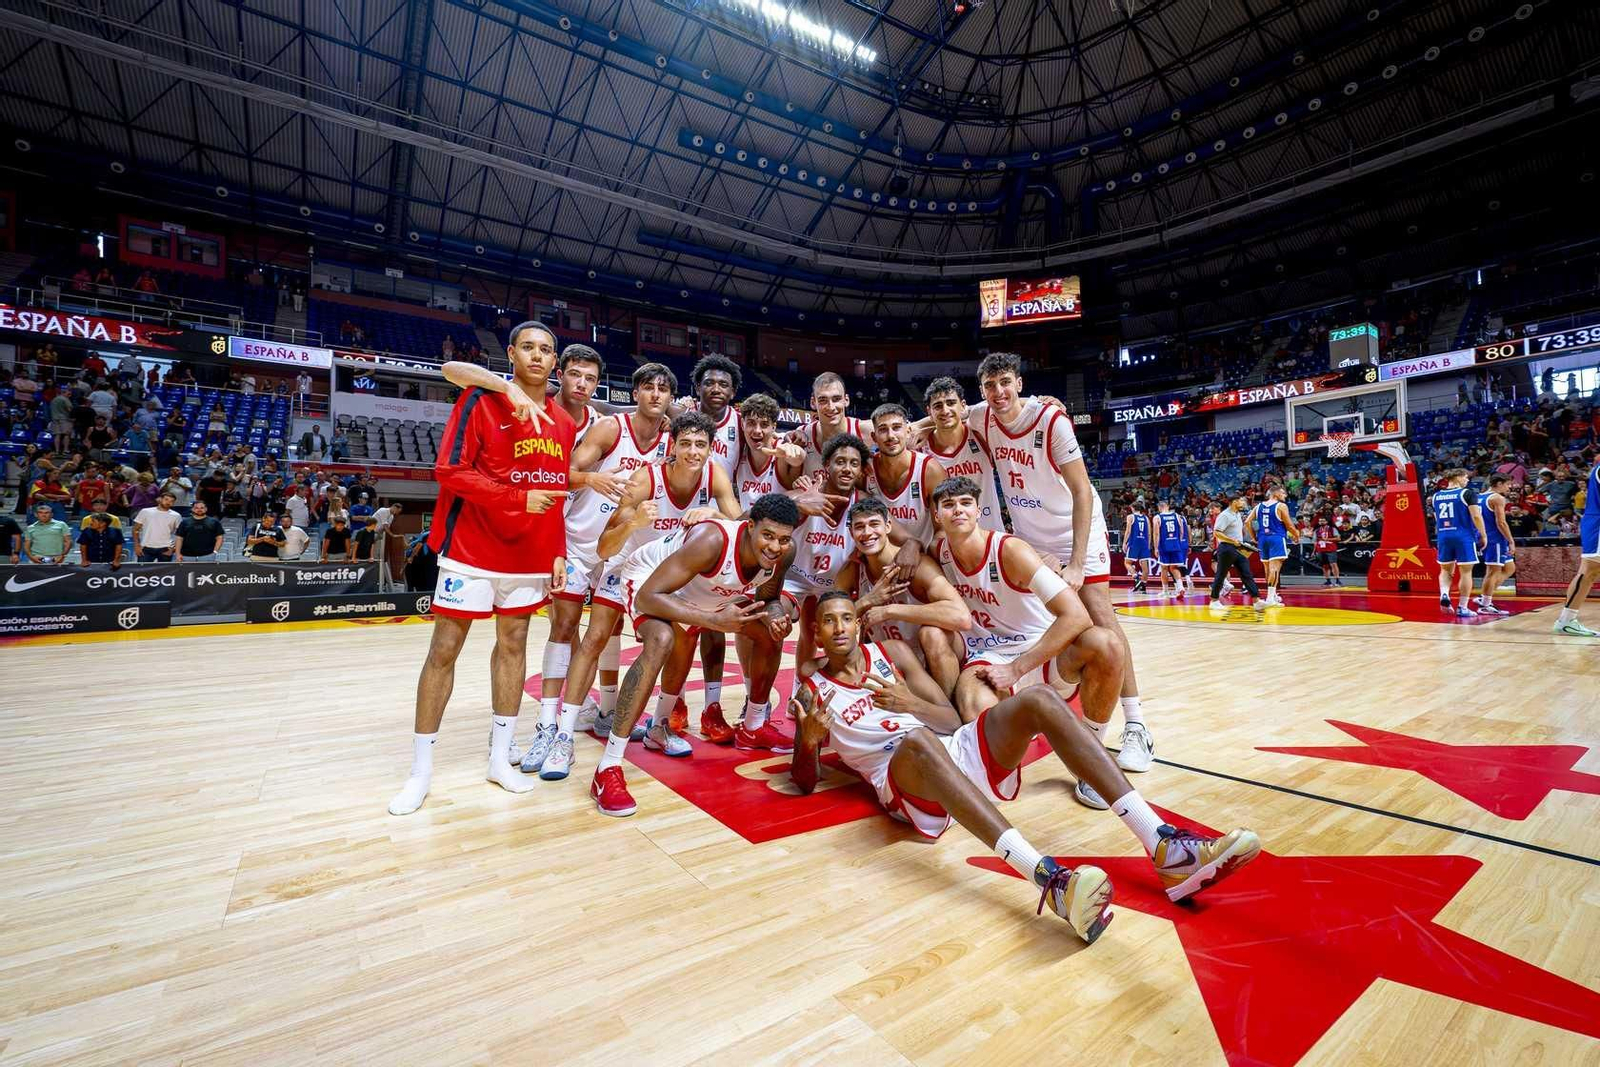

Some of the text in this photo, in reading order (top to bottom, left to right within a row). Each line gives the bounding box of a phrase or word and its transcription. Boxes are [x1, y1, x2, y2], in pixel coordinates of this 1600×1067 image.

[1012, 298, 1075, 316] ESPAÑA B
[0, 308, 137, 344] ESPAÑA B
[1331, 325, 1367, 341] 73:39
[1485, 327, 1600, 360] 80 73:39
[244, 344, 310, 361] ESPAÑA B
[1391, 360, 1438, 376] ESPAÑA
[1442, 358, 1451, 367] B
[1239, 381, 1315, 405] ESPAÑA B
[778, 409, 812, 424] AÑA B
[1114, 403, 1178, 423] ESPAÑA B
[513, 437, 564, 461] ESPAÑA
[510, 467, 566, 485] endesa
[946, 460, 983, 477] PAÑA
[1008, 470, 1025, 490] 15
[890, 505, 918, 520] AÑA
[1438, 502, 1455, 519] 21
[813, 554, 831, 571] 13
[86, 572, 176, 589] endesa
[215, 571, 277, 585] CaixaBank
[791, 564, 835, 587] endes
[1378, 570, 1433, 581] CaixaBank
[313, 601, 397, 616] #LaFamilia
[29, 614, 89, 624] ESPAÑOLA
[970, 609, 996, 629] 12
